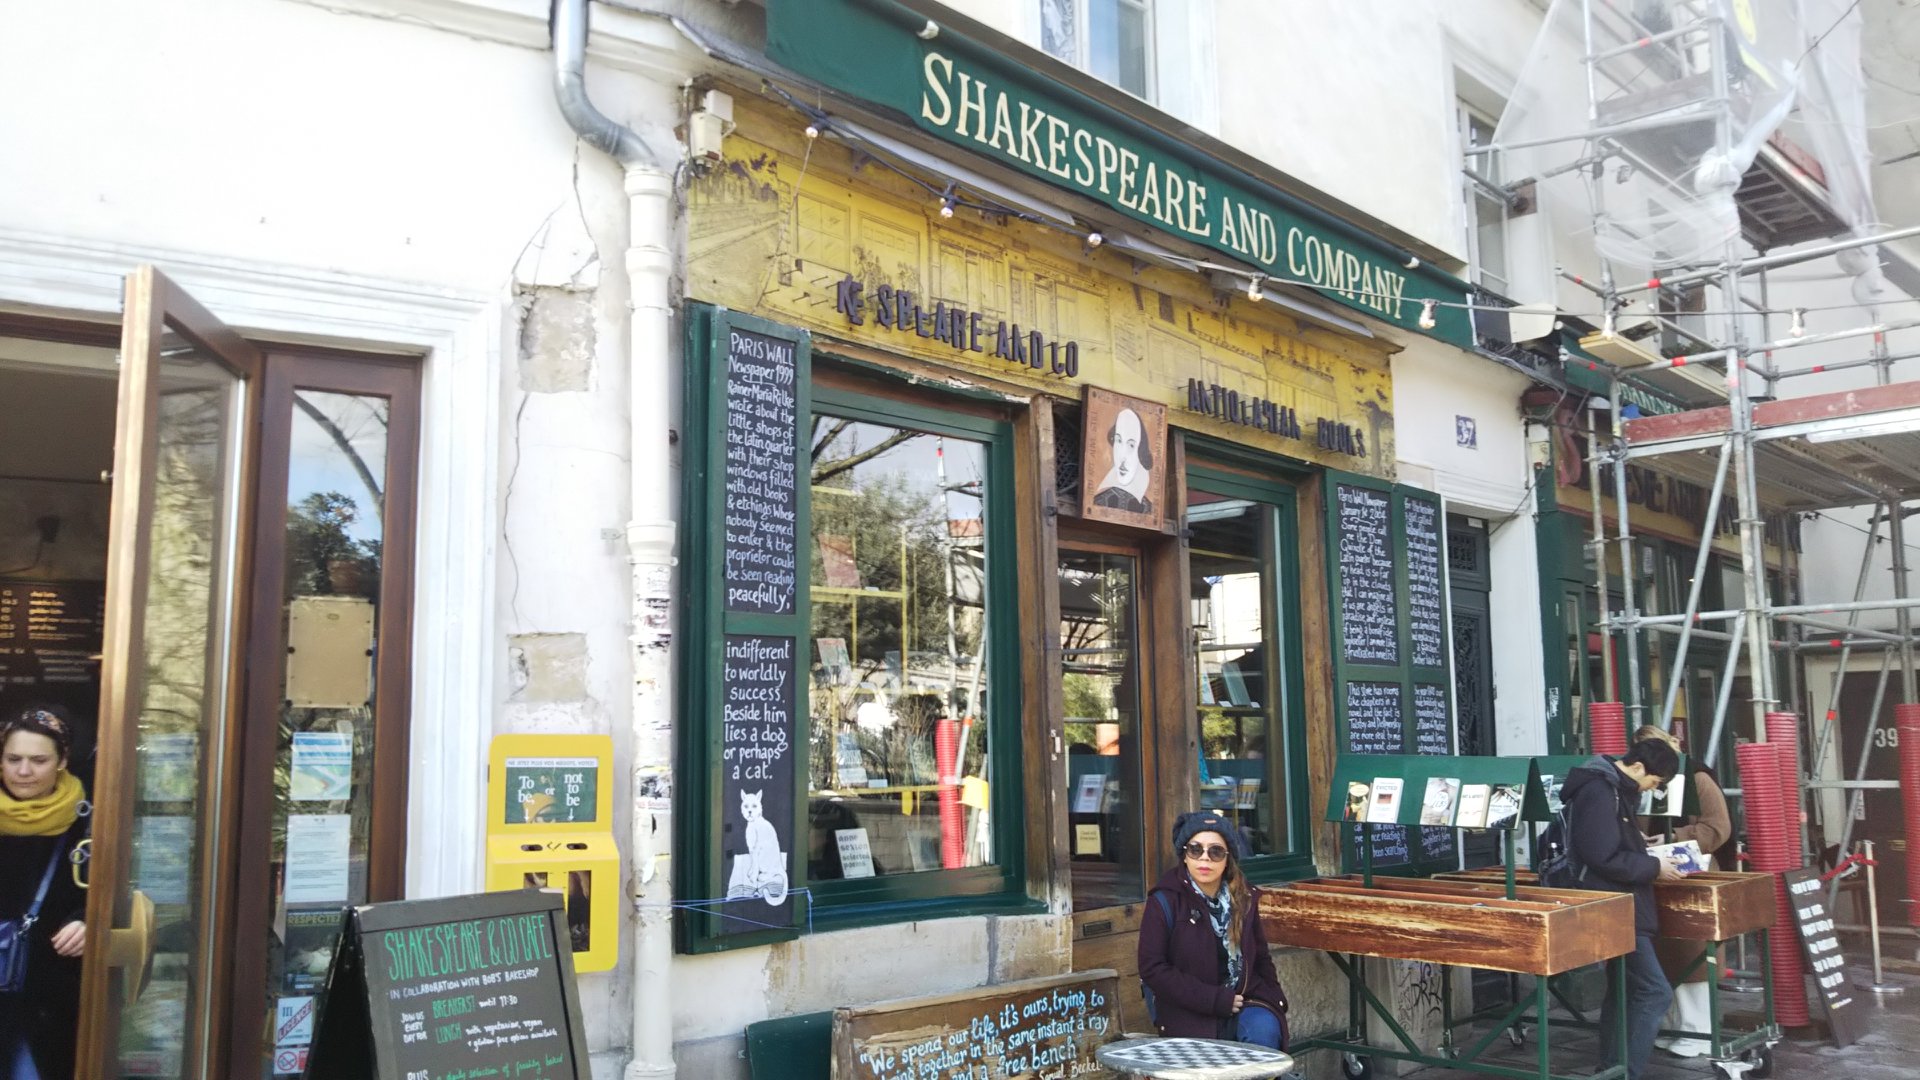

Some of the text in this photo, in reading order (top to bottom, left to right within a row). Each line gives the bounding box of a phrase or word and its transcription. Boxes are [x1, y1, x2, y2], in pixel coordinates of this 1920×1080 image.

[922, 53, 1405, 319] SHAKESPEARE AND COMPANY
[730, 333, 795, 367] PARIS WALL
[996, 320, 1044, 370] AND
[728, 354, 775, 385] Newspaper
[727, 380, 795, 408] Rainer Maria Rilke
[728, 398, 795, 426] wrote about the
[728, 429, 743, 444] the
[765, 437, 795, 458] quarter
[756, 420, 782, 441] shops
[783, 426, 795, 446] of
[727, 447, 795, 477] with their shop
[727, 462, 794, 490] windows filled
[726, 477, 789, 503] with old books
[727, 494, 735, 511] &
[726, 513, 794, 538] nobody seemed
[726, 530, 793, 553] to enter & the
[726, 548, 794, 569] proprietor could
[727, 564, 795, 595] be seen reading
[726, 639, 790, 663] indifferent
[725, 663, 786, 687] to worldly
[730, 687, 785, 703] success.
[724, 702, 786, 723] Beside him
[725, 723, 788, 752] lies a dog
[1874, 727, 1899, 748] 39
[723, 743, 781, 764] or perhaps
[518, 776, 535, 789] To
[564, 773, 583, 784] not
[732, 762, 773, 780] a cat.
[545, 788, 555, 796] or
[566, 793, 580, 807] be
[568, 784, 579, 794] to
[385, 914, 552, 981] SHAKESPEARE & CO CAFE
[403, 979, 460, 997] COLLABORATION
[461, 975, 480, 988] WITH
[504, 967, 539, 983] BAKESHOP
[436, 1022, 462, 1044] LUNCH
[901, 1034, 943, 1066] spend
[949, 1030, 968, 1047] our
[999, 1004, 1019, 1032] it's
[1052, 990, 1086, 1017] trying
[1090, 989, 1104, 1006] to
[919, 1048, 967, 1079] together
[970, 1042, 982, 1059] in
[986, 1037, 1005, 1057] the
[1008, 1029, 1036, 1050] same
[1037, 1015, 1075, 1040] instant
[1077, 1016, 1086, 1032] a
[1088, 1016, 1110, 1036] ray
[997, 1054, 1028, 1076] free
[1031, 1037, 1077, 1069] bench
